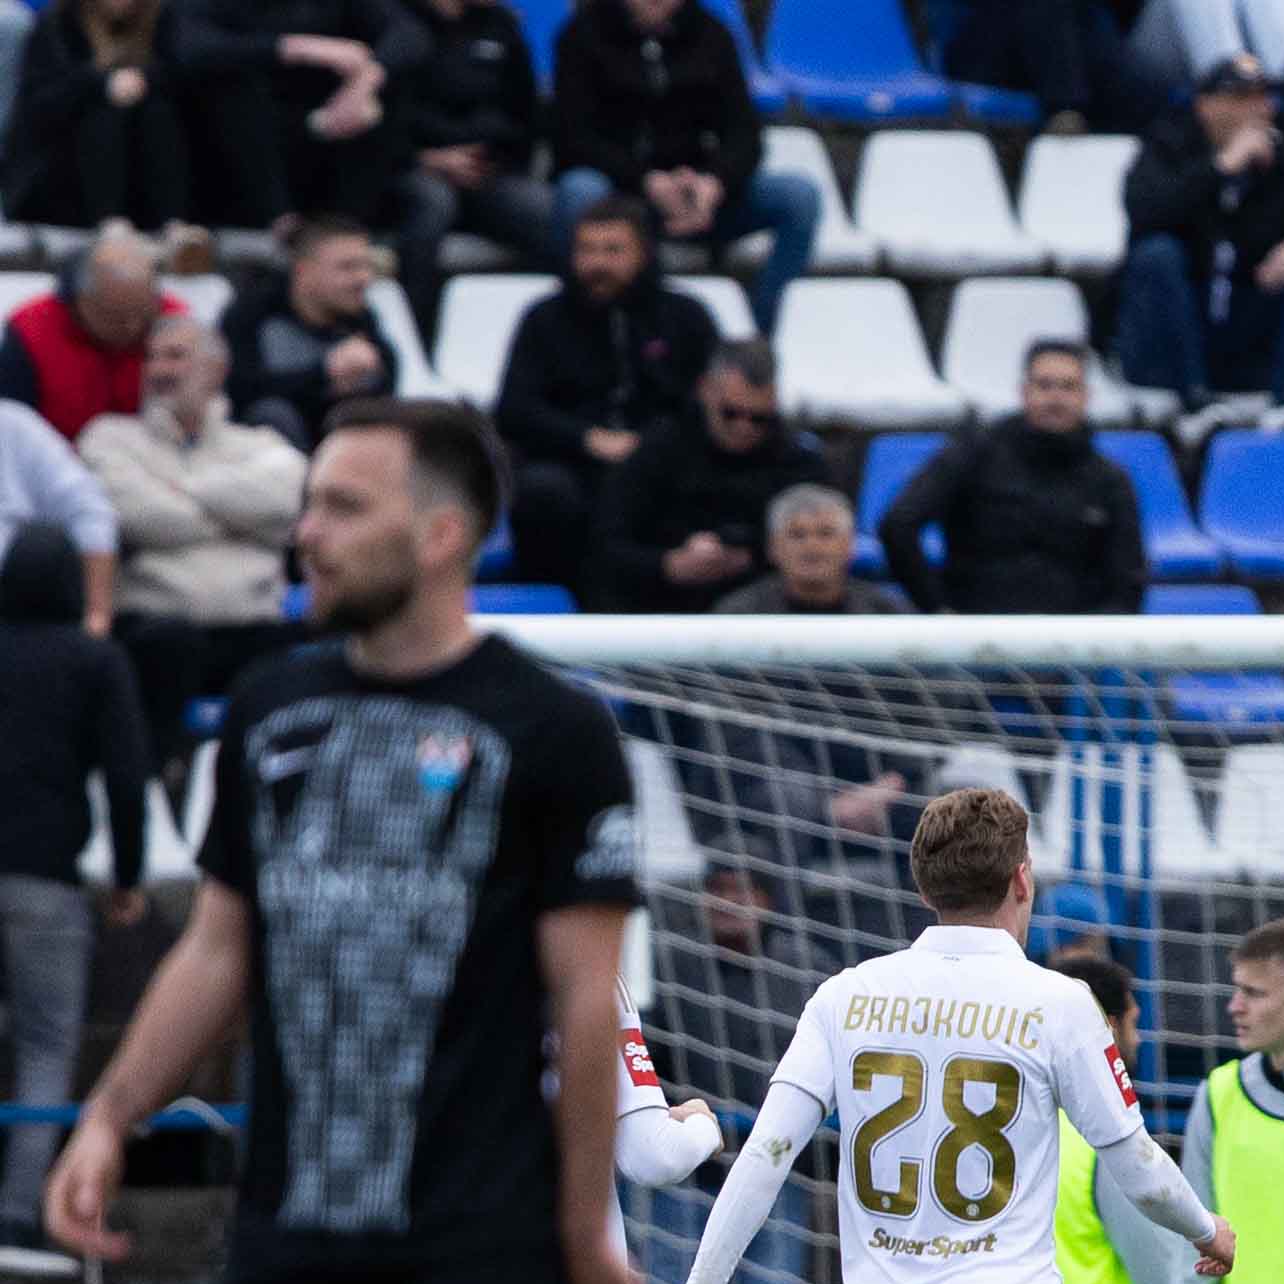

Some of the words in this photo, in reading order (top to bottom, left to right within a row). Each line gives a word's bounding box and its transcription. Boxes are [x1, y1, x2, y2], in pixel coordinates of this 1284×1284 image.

[844, 993, 1044, 1050] BRAJKOVIĆ
[849, 1046, 1026, 1226] 28
[868, 1226, 998, 1259] SuperSport
